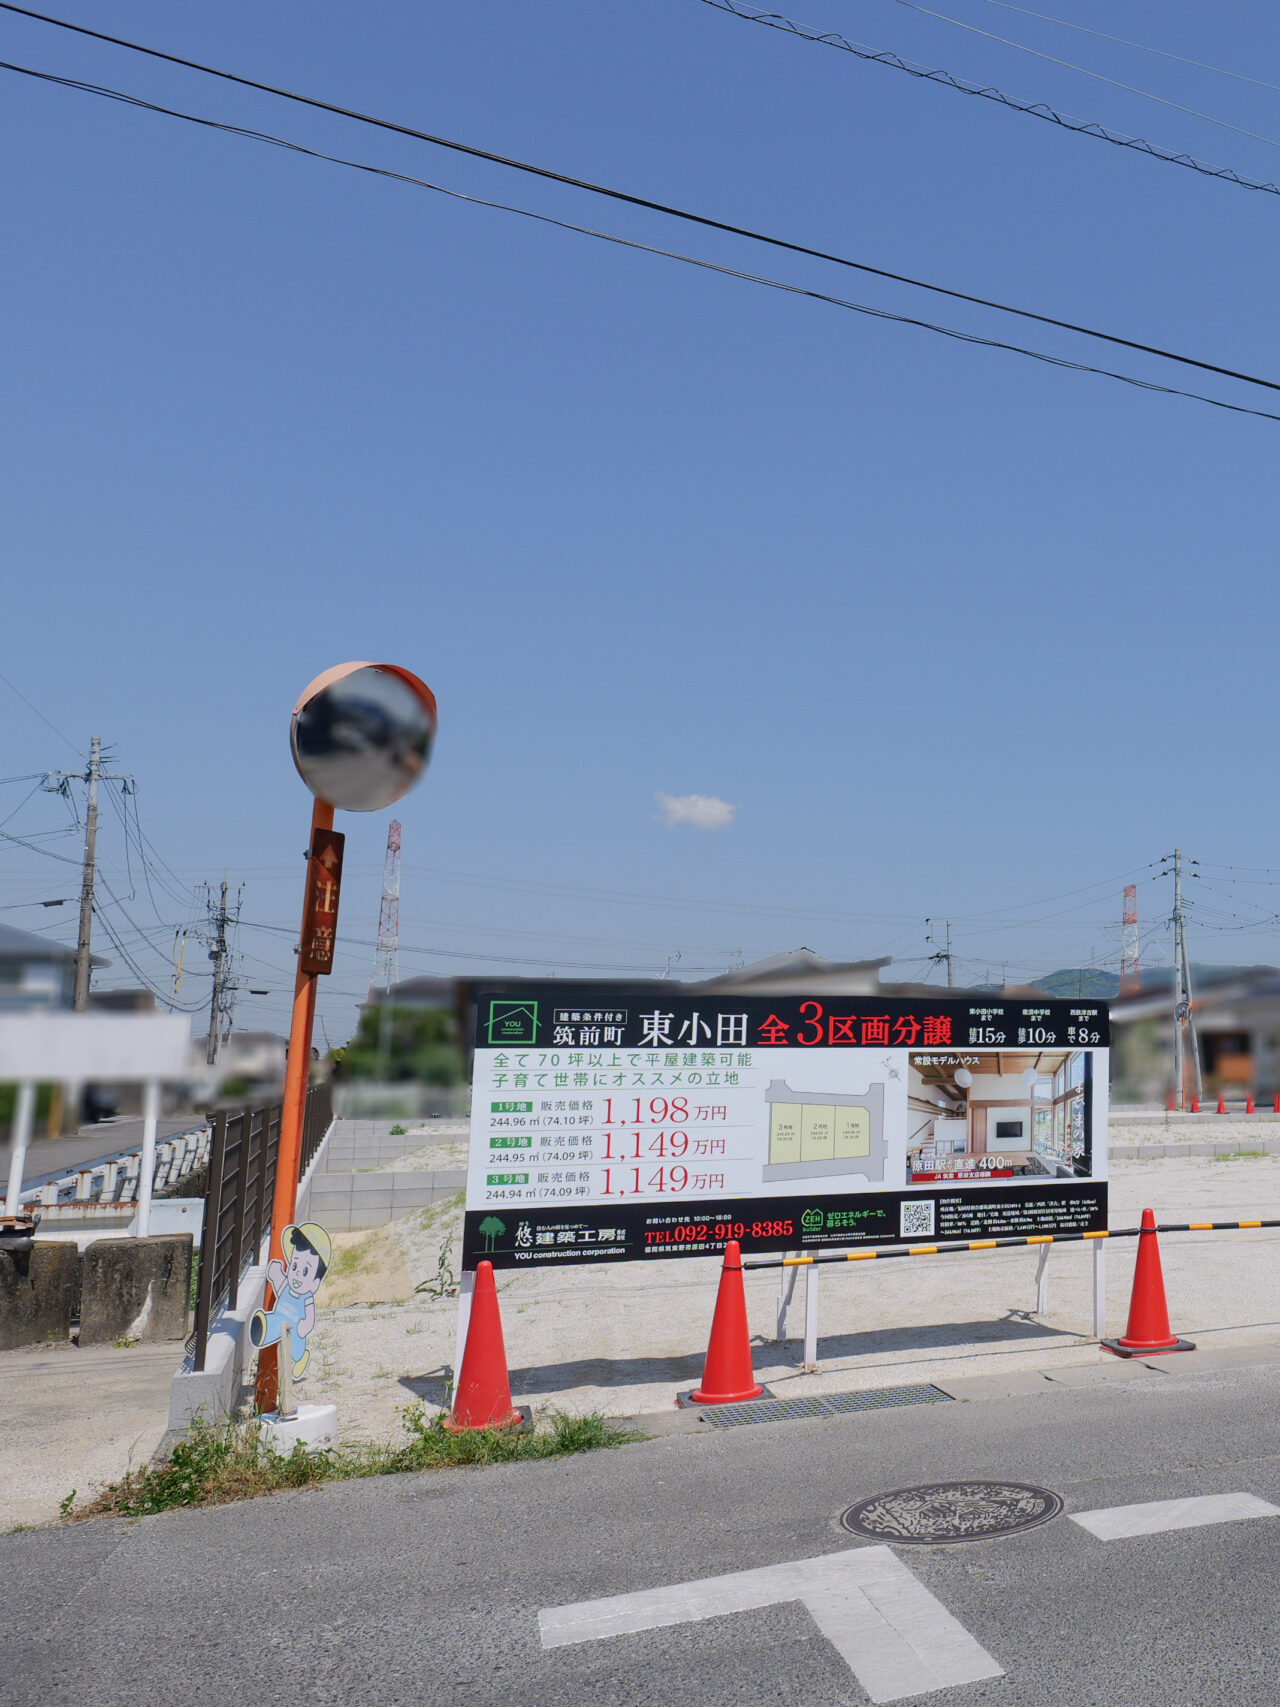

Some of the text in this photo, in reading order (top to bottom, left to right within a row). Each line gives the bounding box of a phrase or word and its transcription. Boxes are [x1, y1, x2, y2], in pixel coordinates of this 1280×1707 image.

[309, 880, 338, 962] 注意
[559, 1012, 624, 1022] 建築条件付き
[968, 1008, 1004, 1016] 東小田小学校
[504, 1020, 521, 1028] YOU
[553, 1001, 953, 1047] 筑前町 東小田 全3区画分譲
[493, 1052, 752, 1068] 全て70坪以上で平屋建築可能
[913, 1055, 980, 1066] 常設モデルハウス
[492, 1071, 740, 1089] 子育て世帯にオススメの立地
[497, 1096, 727, 1127] 1号地 販売価格 1,198万円
[495, 1130, 726, 1162] 2号地 販売価格 1,149万円
[979, 1156, 1013, 1170] 400m
[491, 1165, 725, 1197] 3号地 販売価格 1,149万円
[645, 1216, 691, 1225] お問い合わせ先
[805, 1215, 821, 1223] ZEH
[515, 1225, 617, 1247] 悠建築工房
[645, 1220, 794, 1244] TEL092-919-8385
[514, 1247, 626, 1260] YOU construction corporation
